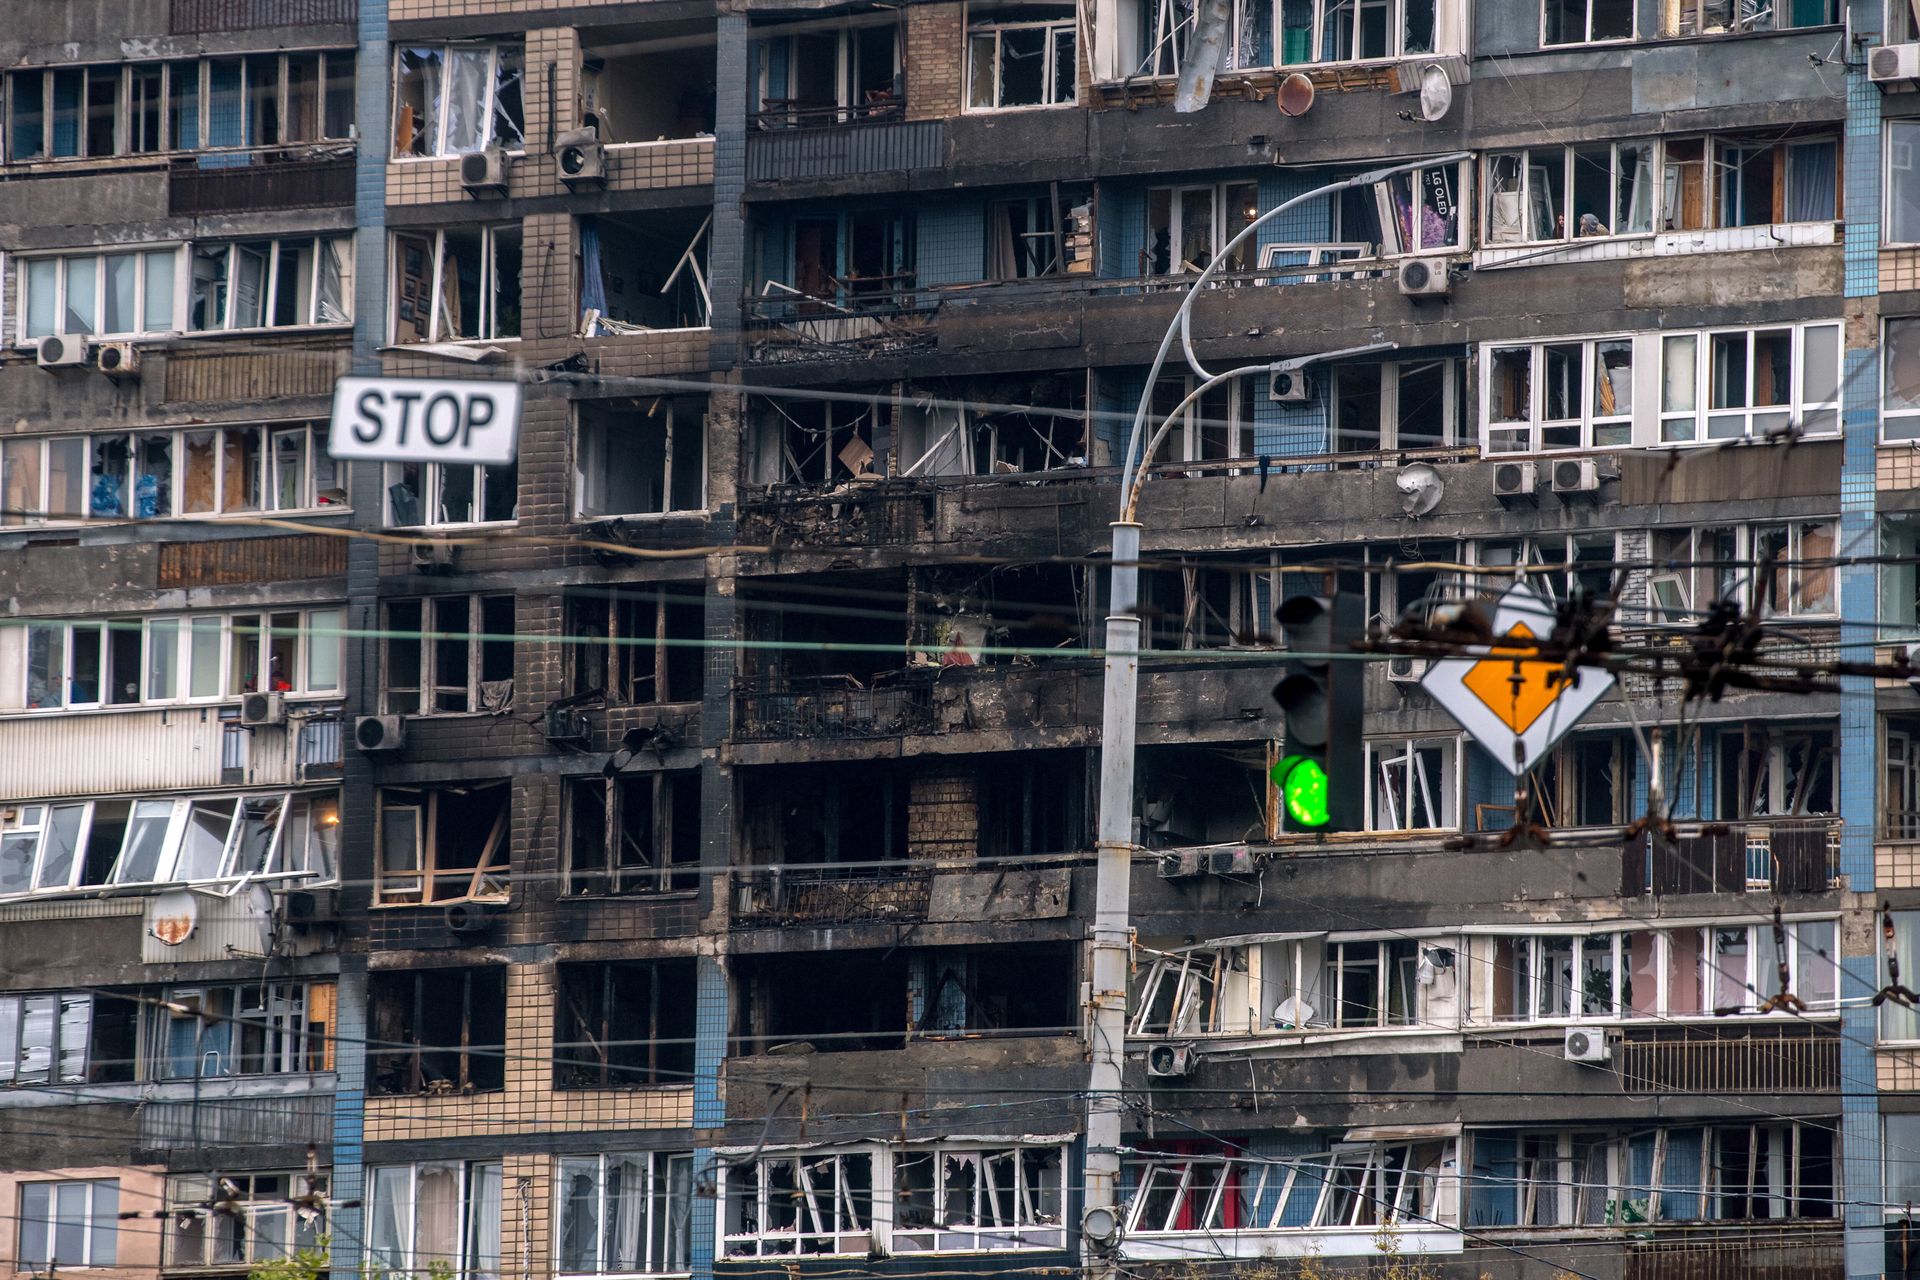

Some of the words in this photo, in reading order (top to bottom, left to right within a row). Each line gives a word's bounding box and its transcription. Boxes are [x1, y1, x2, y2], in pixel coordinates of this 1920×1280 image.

[1432, 171, 1442, 185] LG
[1435, 188, 1447, 215] OLED
[351, 388, 495, 448] STOP
